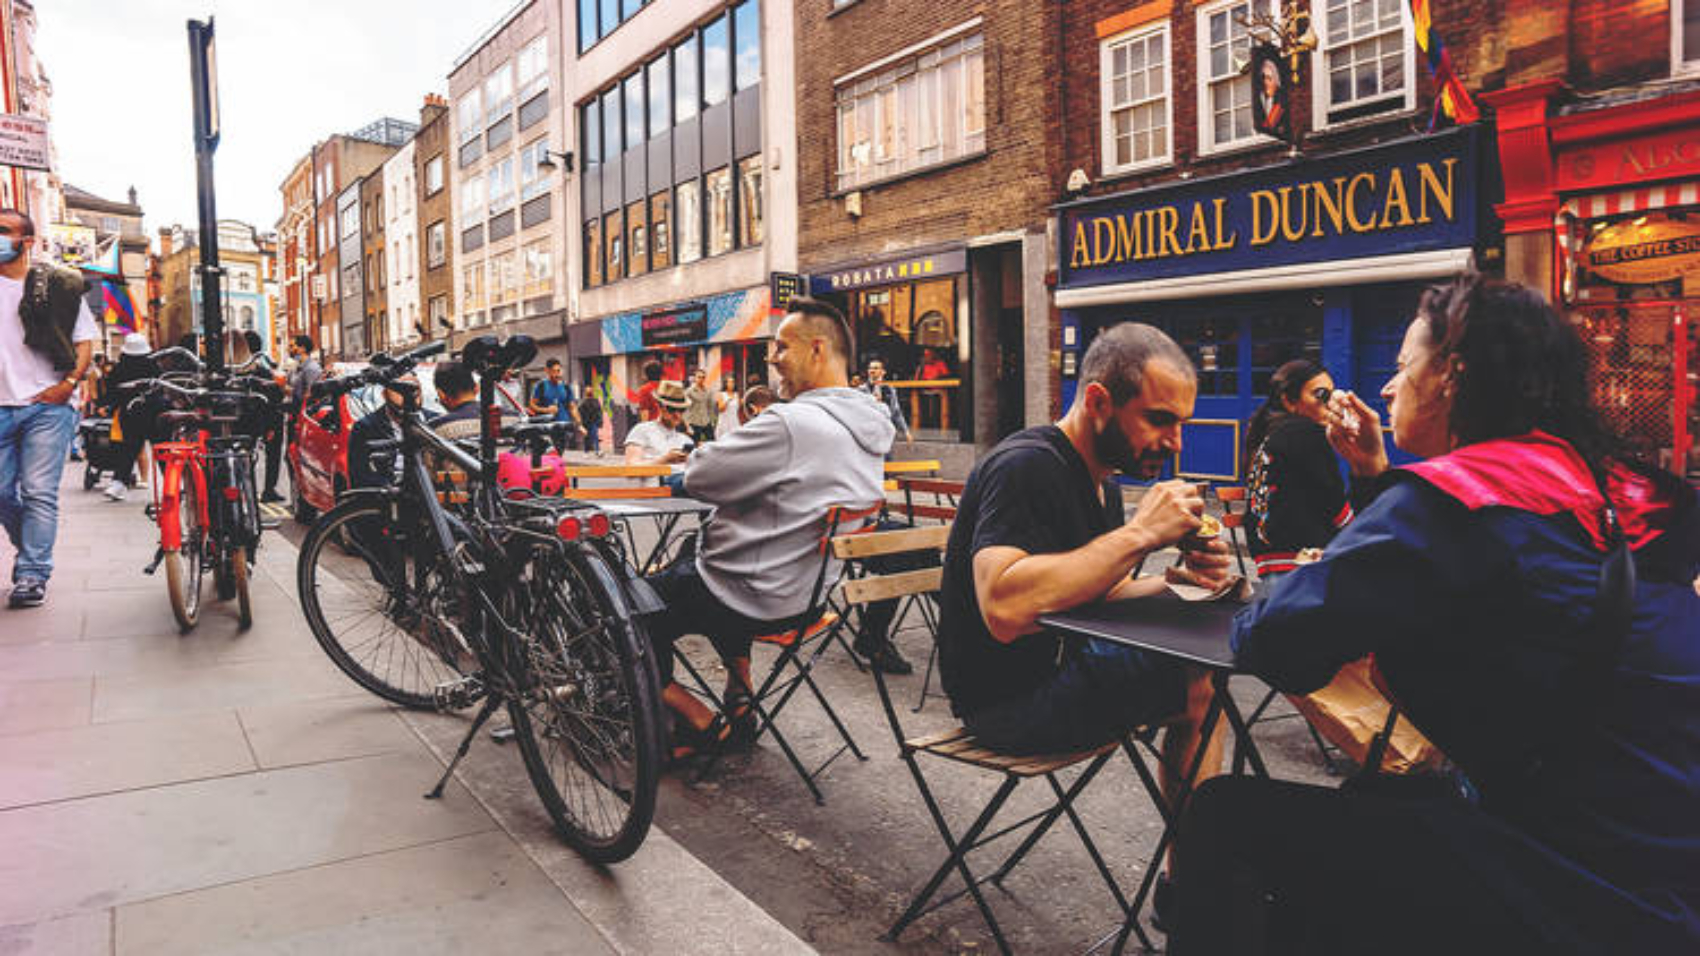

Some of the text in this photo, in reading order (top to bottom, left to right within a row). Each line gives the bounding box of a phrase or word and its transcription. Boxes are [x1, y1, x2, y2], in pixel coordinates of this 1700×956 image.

[1070, 158, 1460, 268] ADMIRAL DUNCAN
[831, 265, 894, 288] ROBATA
